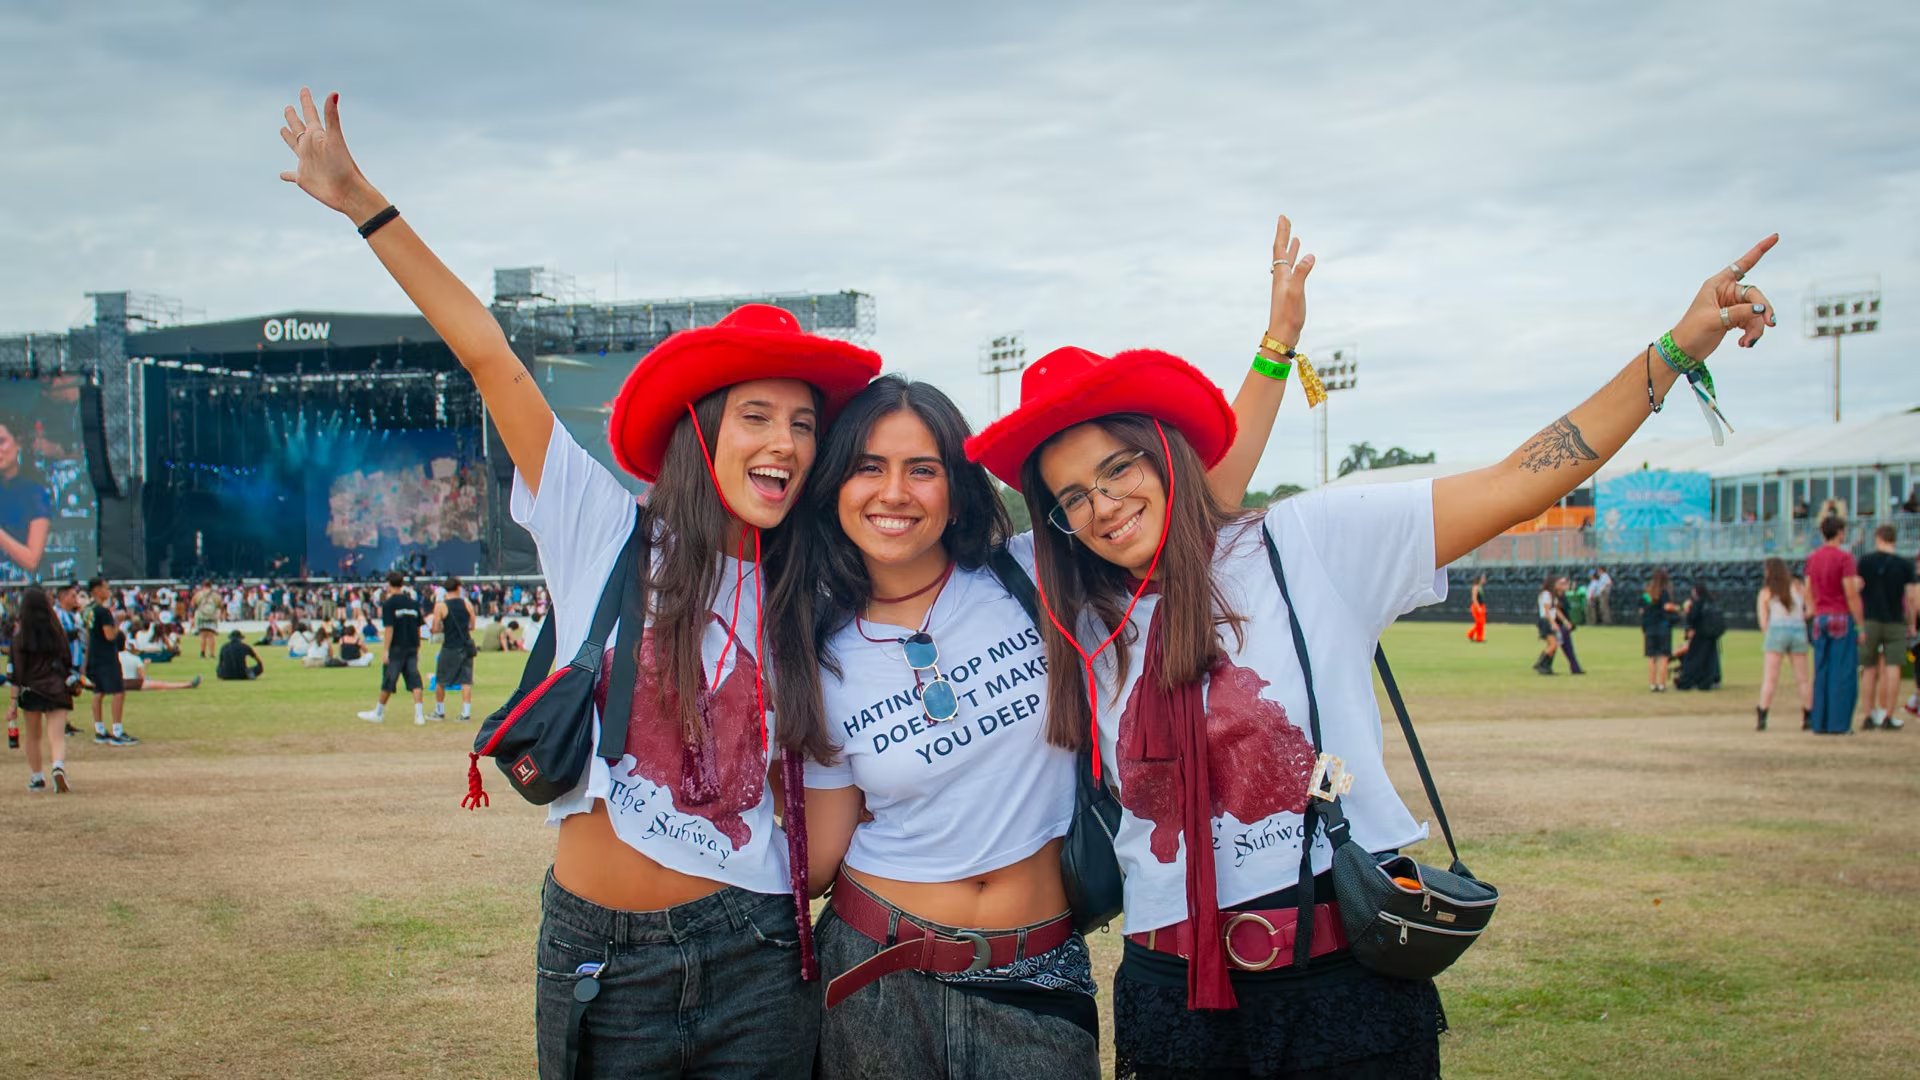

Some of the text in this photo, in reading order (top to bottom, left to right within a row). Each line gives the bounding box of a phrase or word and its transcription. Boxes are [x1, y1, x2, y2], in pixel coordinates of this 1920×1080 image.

[284, 318, 331, 340] flow
[938, 656, 982, 684] OP
[872, 688, 978, 754] DOE'T
[915, 693, 1040, 764] YOU DEEP
[609, 778, 730, 869] The Subway
